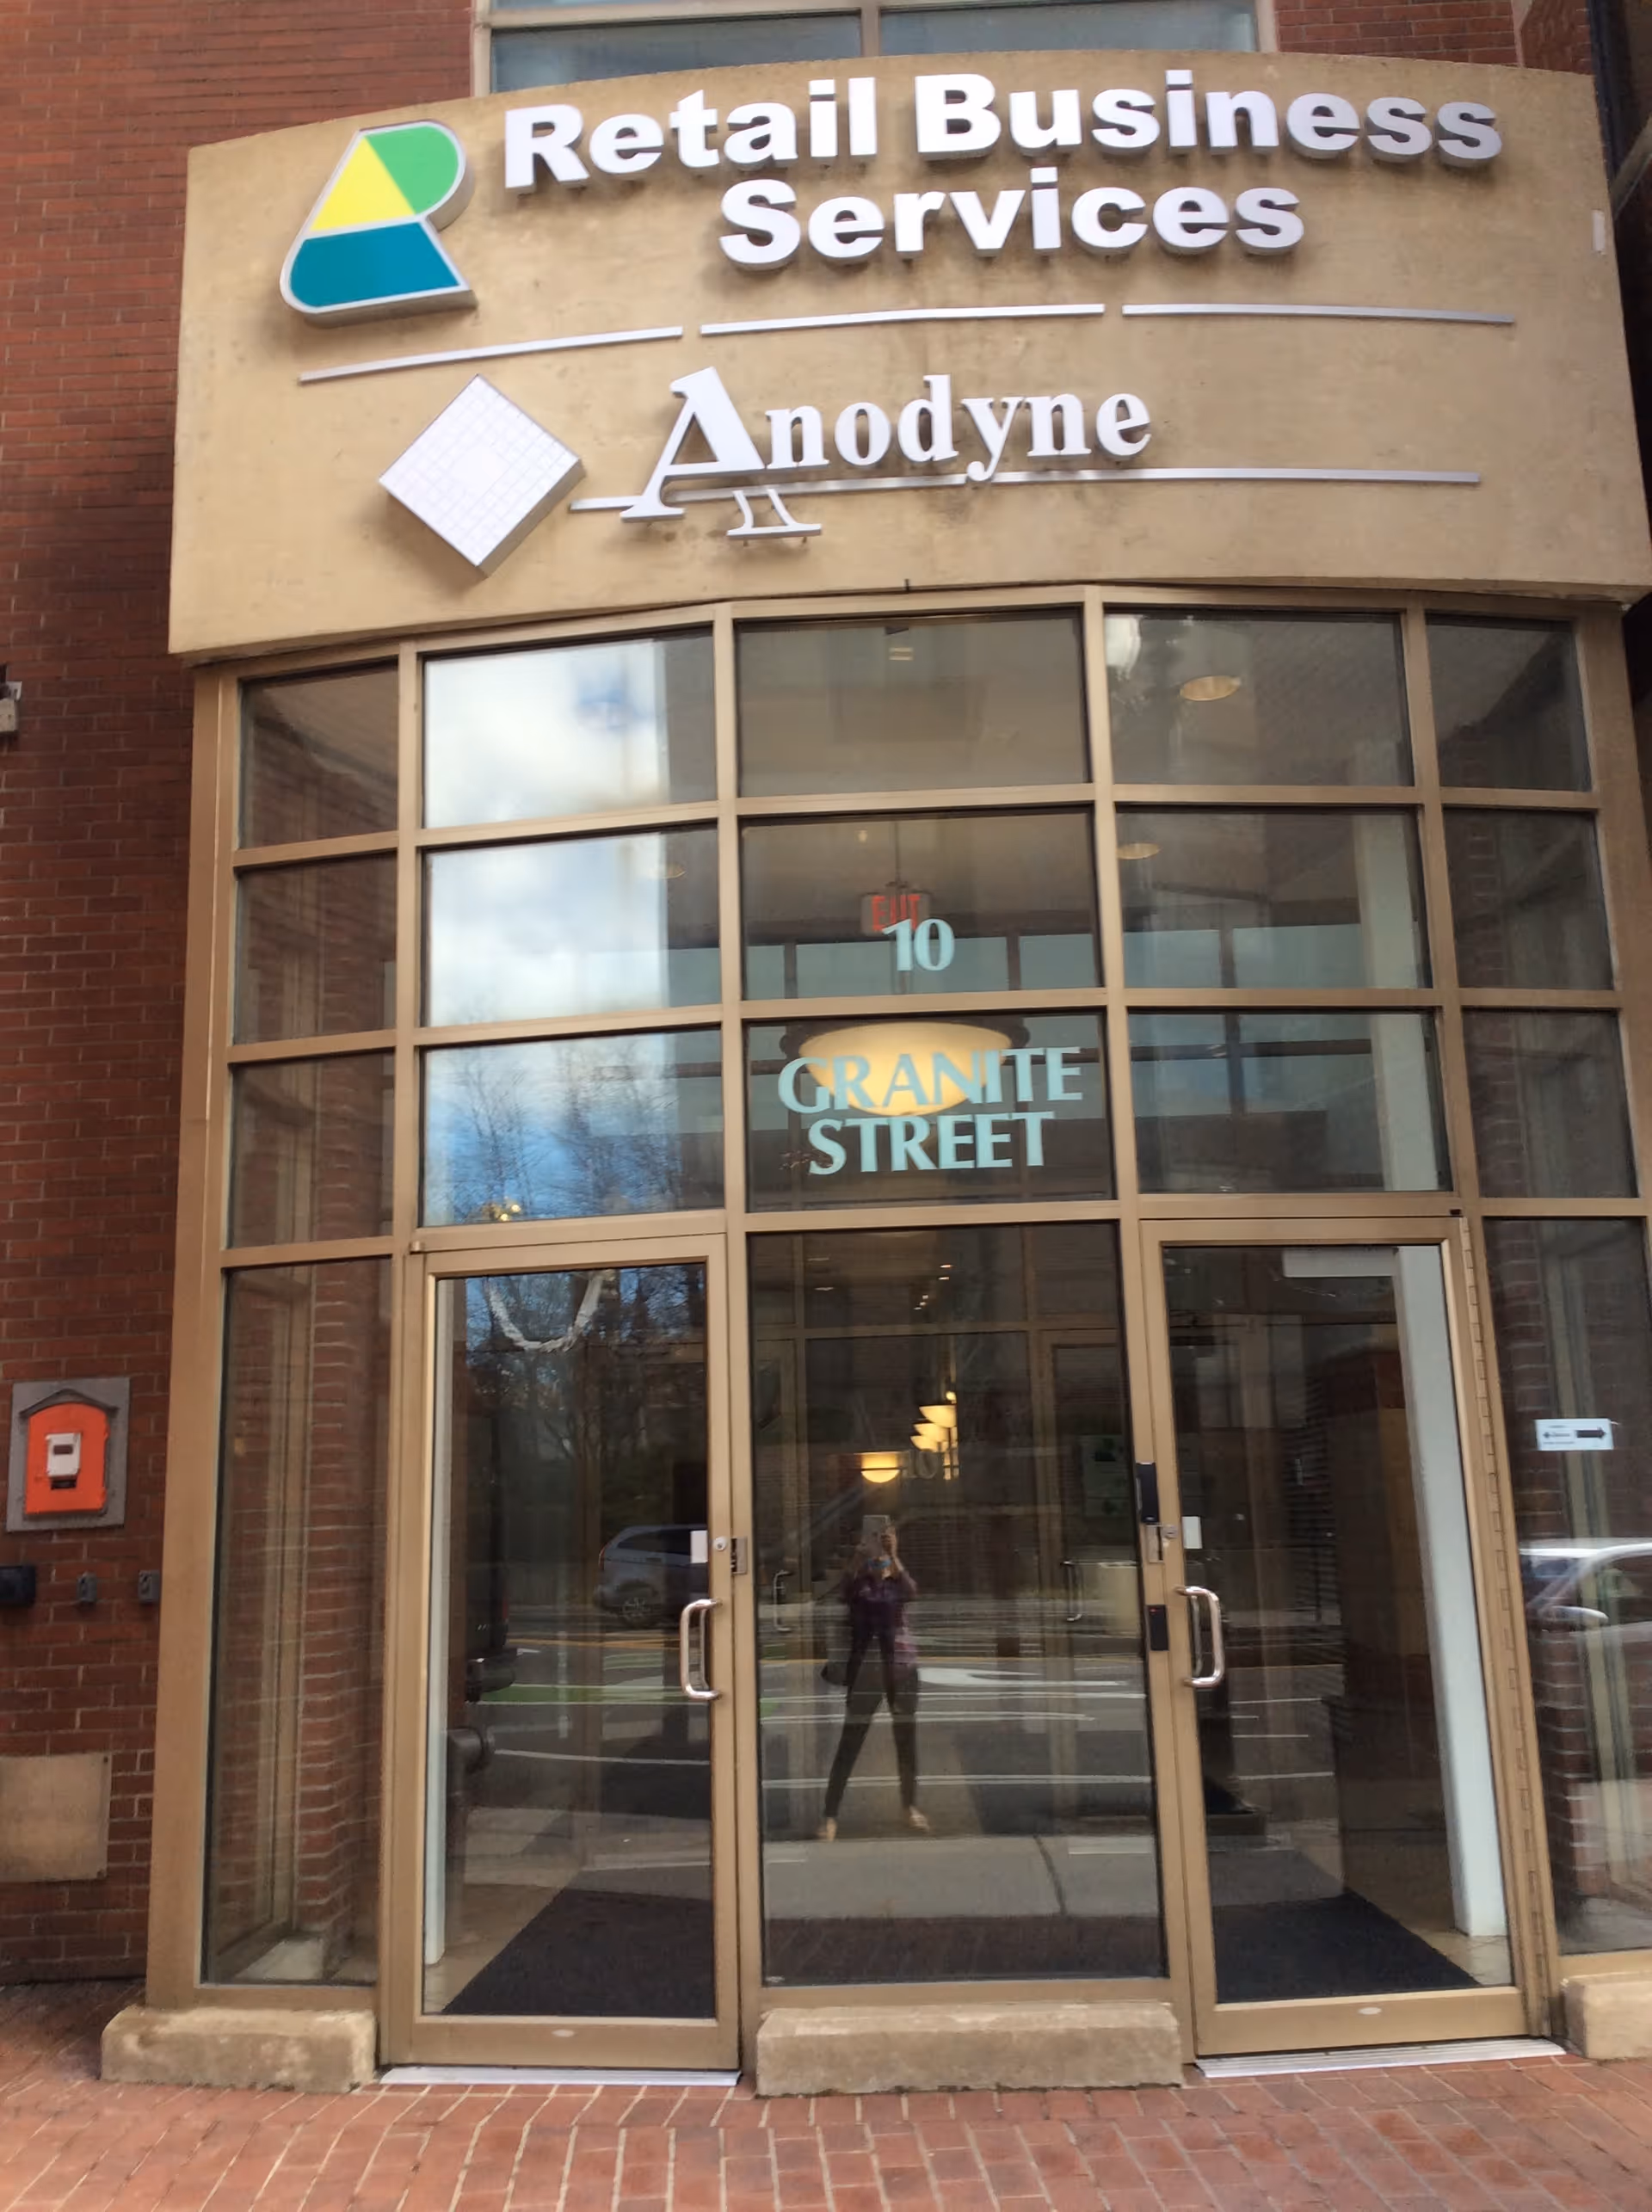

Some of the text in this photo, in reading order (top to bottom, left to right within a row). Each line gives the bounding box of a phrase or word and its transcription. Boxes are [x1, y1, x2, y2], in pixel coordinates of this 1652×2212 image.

[504, 70, 1504, 193] Retail Business
[718, 166, 1306, 268] Services
[620, 366, 1152, 537] Anodyne
[882, 918, 955, 971] 10
[778, 1047, 1082, 1113] GRANITE
[808, 1111, 1056, 1175] STREET
